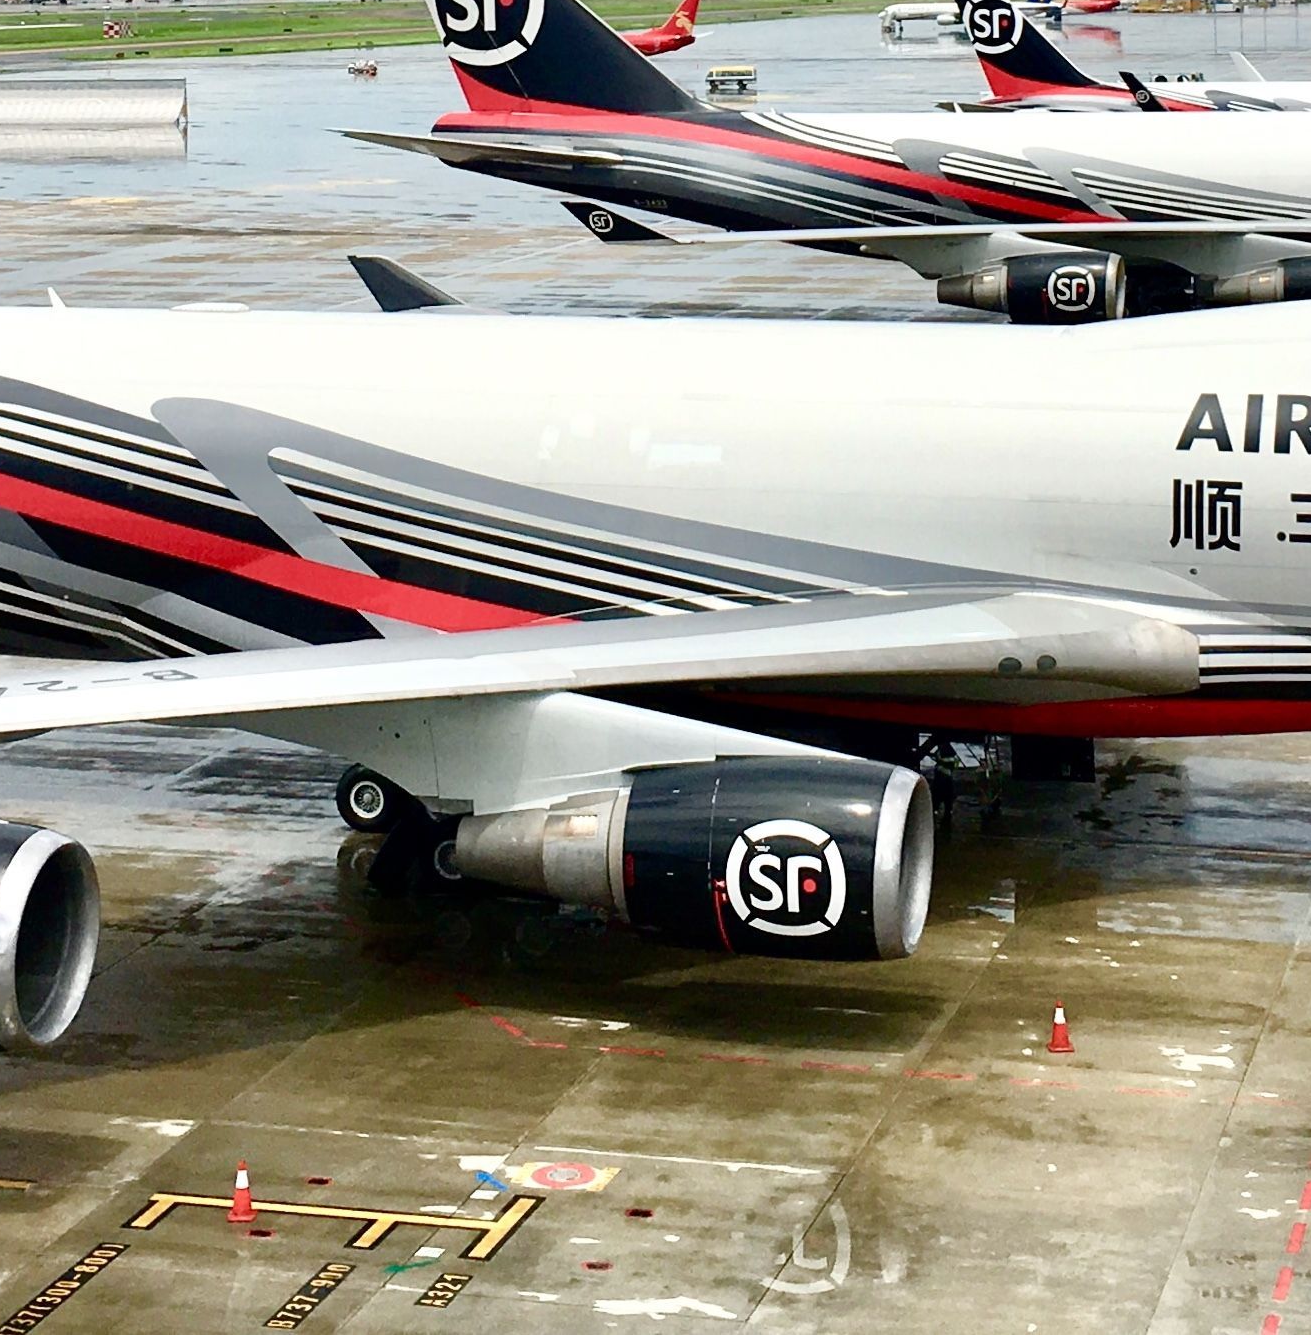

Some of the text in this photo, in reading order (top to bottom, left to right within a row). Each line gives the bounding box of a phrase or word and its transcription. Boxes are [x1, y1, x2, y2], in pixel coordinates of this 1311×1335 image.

[973, 8, 1011, 39] SF
[1056, 277, 1087, 301] SF
[748, 853, 823, 913] SF
[267, 1263, 351, 1329] B737-900
[419, 1272, 471, 1308] A321
